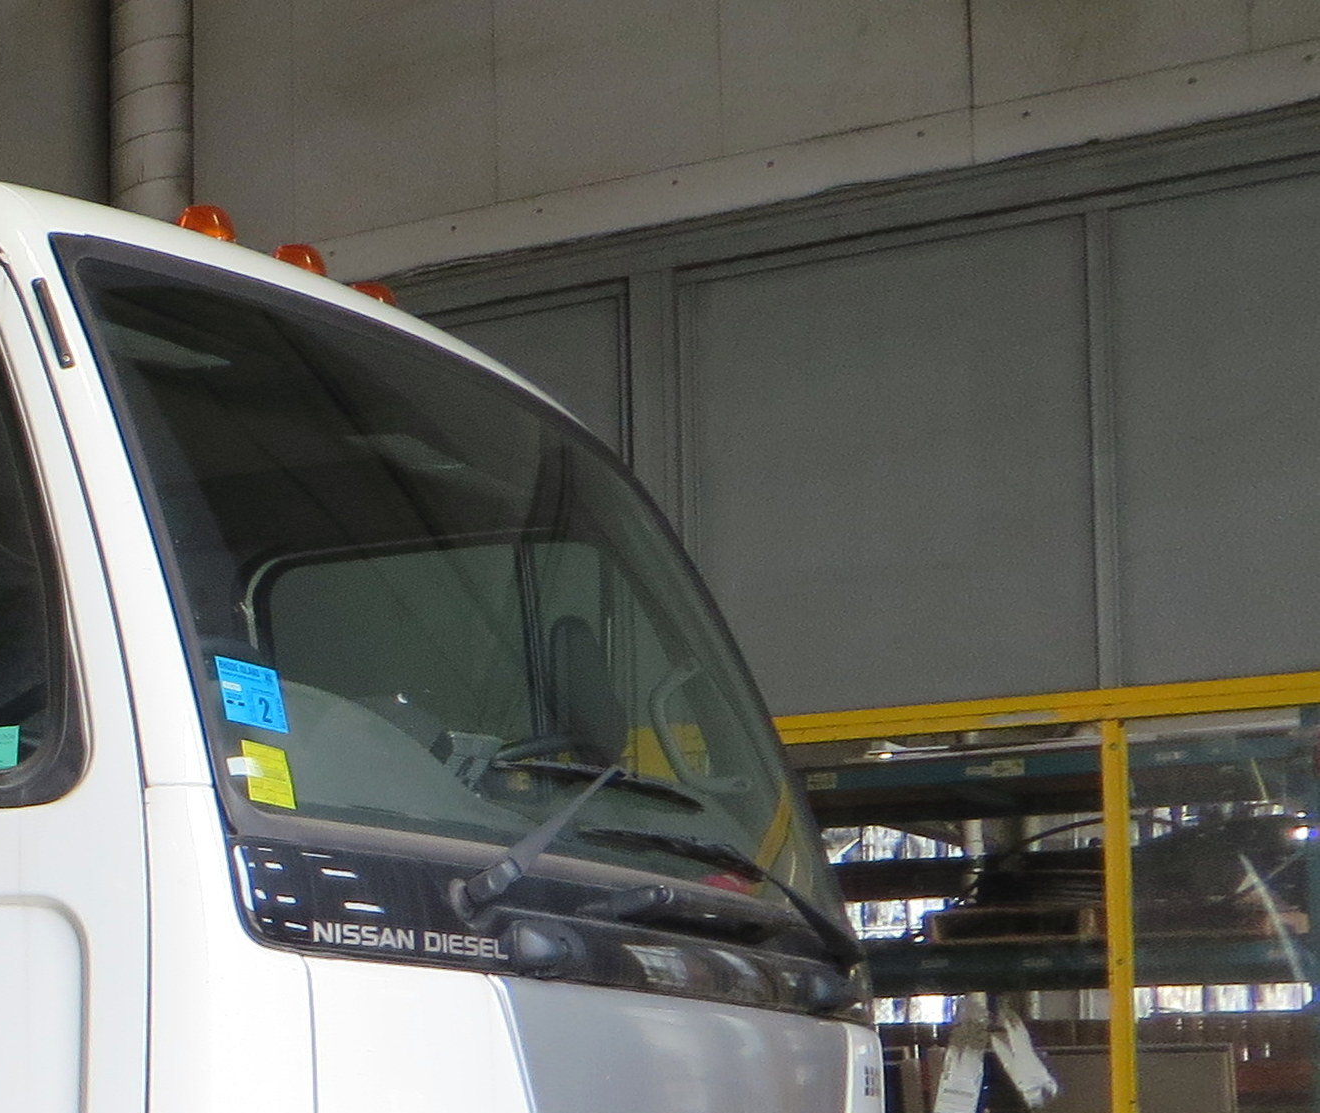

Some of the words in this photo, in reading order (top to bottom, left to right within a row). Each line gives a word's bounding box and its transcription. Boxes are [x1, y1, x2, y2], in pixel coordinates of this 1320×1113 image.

[259, 696, 273, 723] 2
[312, 920, 415, 950] NISSAN
[423, 931, 509, 961] DIESEL
